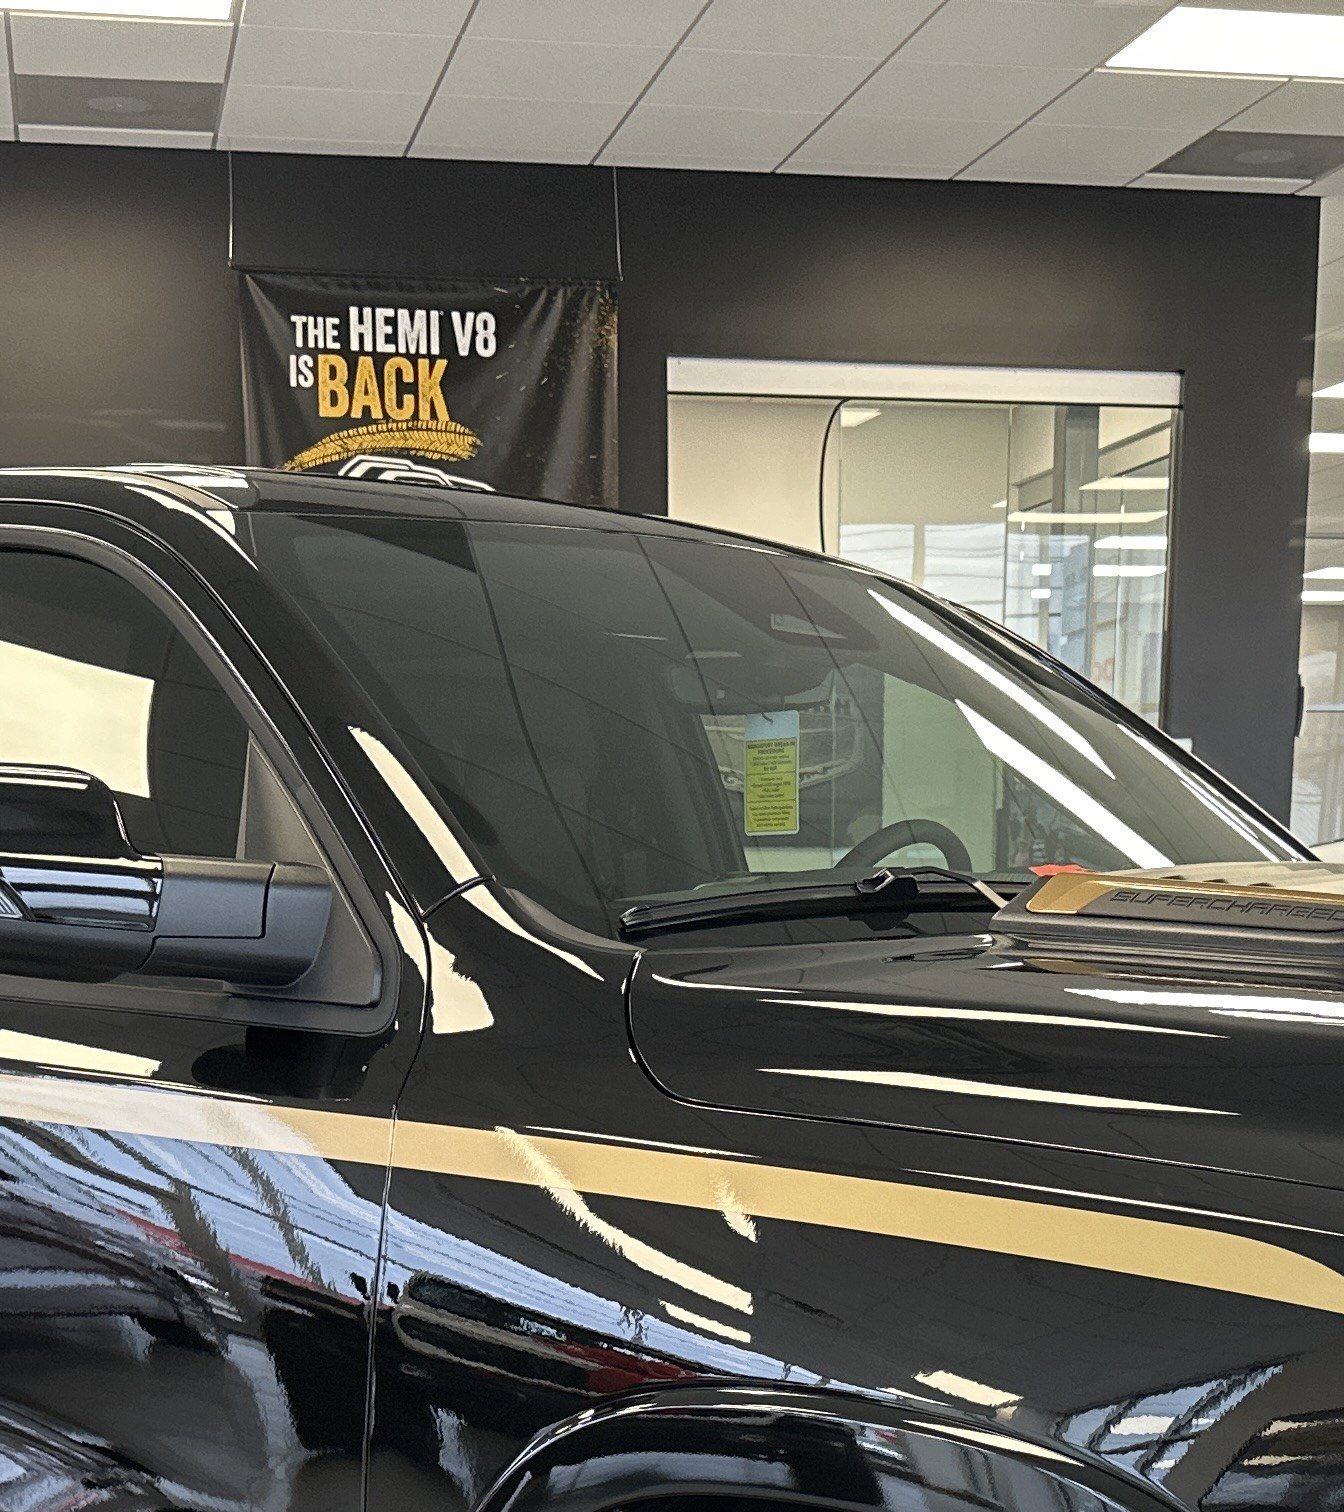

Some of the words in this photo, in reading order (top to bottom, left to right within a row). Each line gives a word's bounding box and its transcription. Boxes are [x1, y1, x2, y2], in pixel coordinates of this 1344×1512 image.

[290, 314, 341, 349] THE
[348, 306, 441, 356] HEMI
[451, 311, 498, 358] V8
[289, 354, 314, 388] IS
[317, 353, 451, 422] BACK
